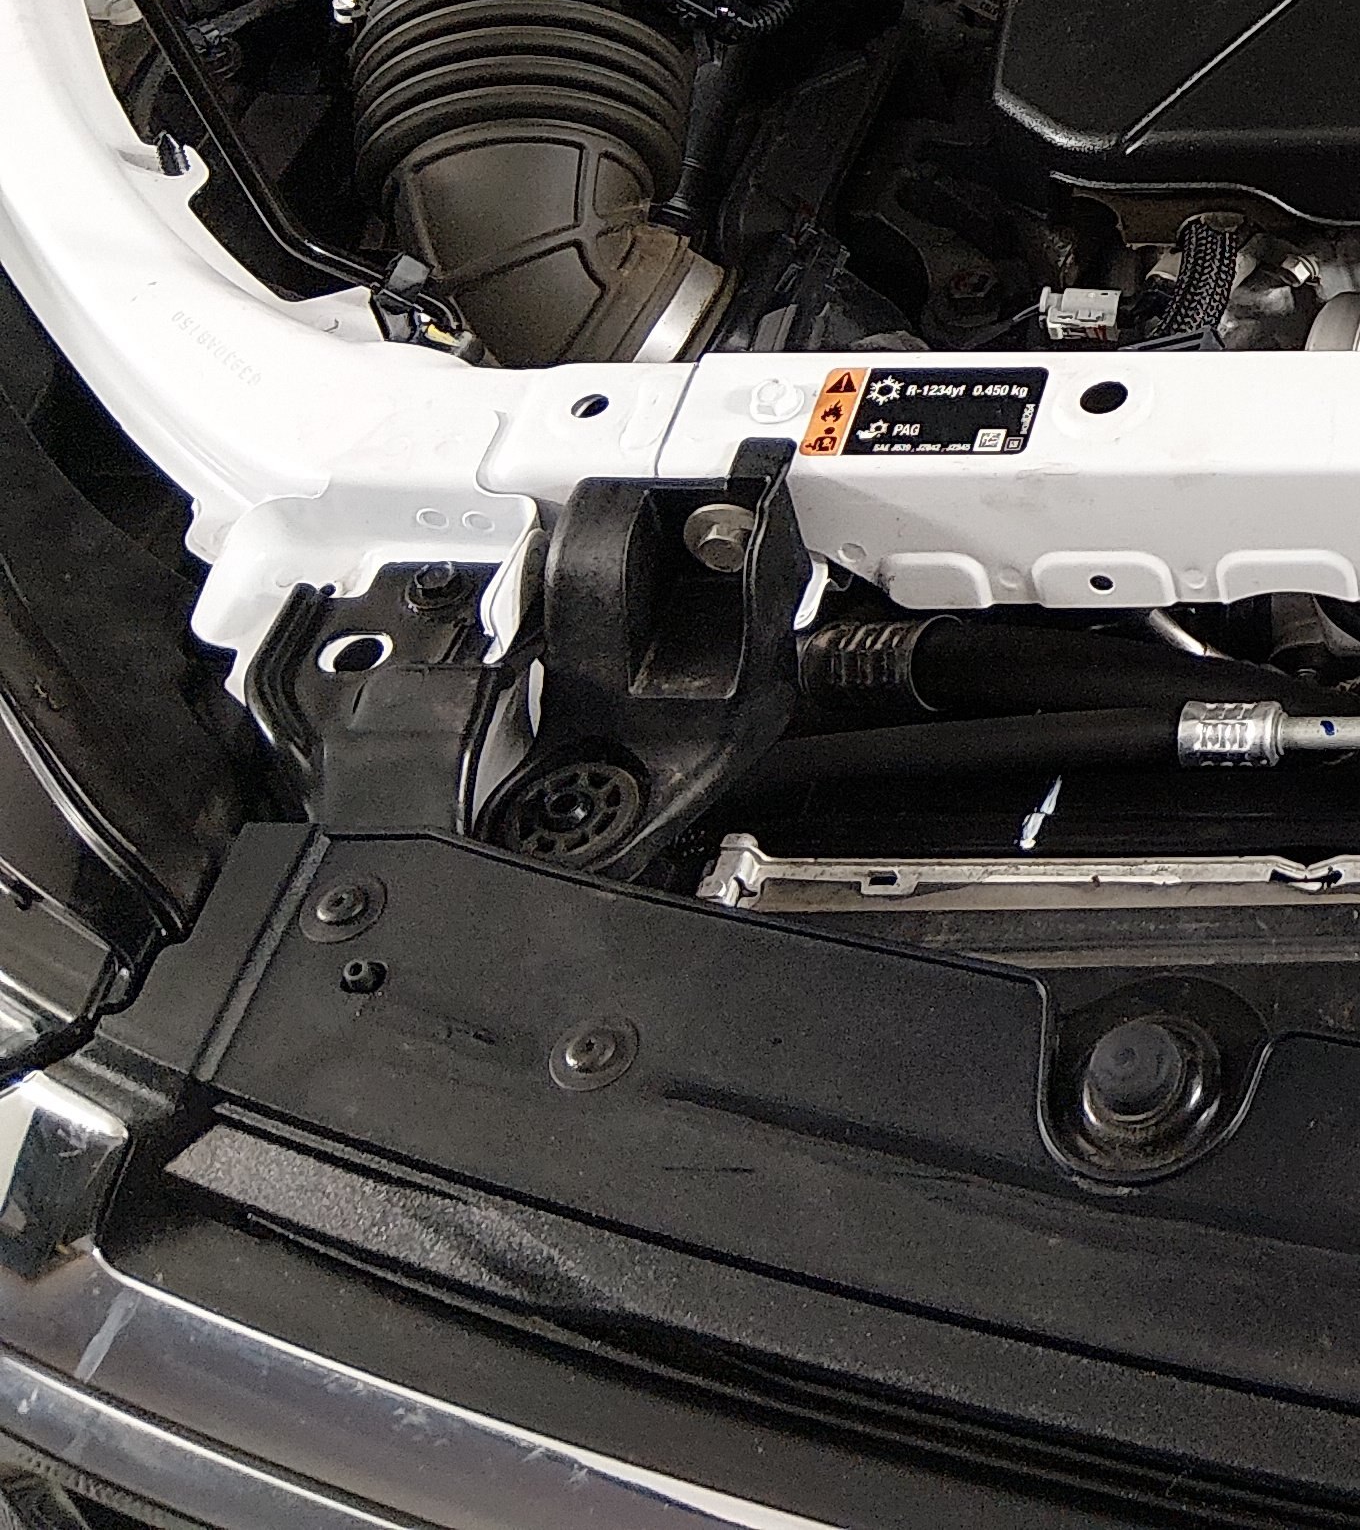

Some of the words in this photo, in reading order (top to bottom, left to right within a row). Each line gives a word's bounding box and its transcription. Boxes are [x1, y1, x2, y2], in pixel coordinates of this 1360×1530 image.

[905, 384, 967, 399] R-1234yf
[971, 384, 1010, 397] 0.450
[1010, 385, 1029, 399] kg
[892, 423, 921, 437] PAG
